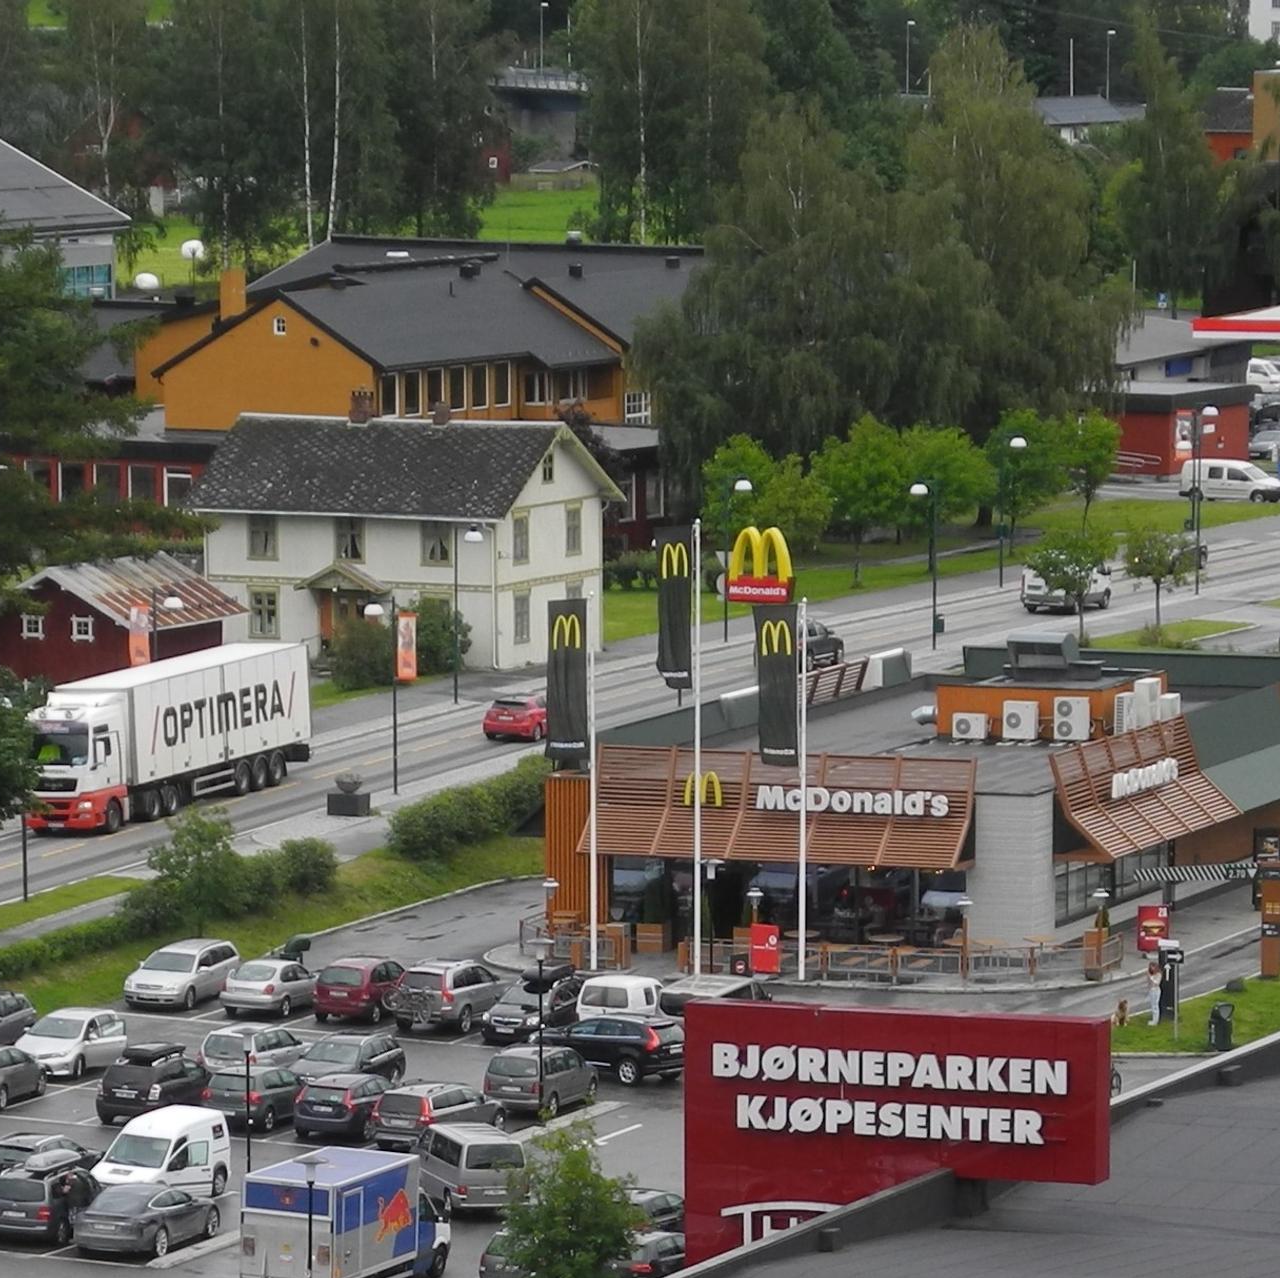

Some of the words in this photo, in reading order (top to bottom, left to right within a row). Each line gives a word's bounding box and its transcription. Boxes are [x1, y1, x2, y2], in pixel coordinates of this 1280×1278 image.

[729, 585, 787, 597] McDonald's
[162, 679, 285, 748] OPTIMERA
[756, 784, 949, 817] McDonald's
[1228, 868, 1246, 879] 2.70
[712, 1042, 1068, 1096] BJØRNEPARKEN
[736, 1093, 1045, 1146] KJØPESENTER
